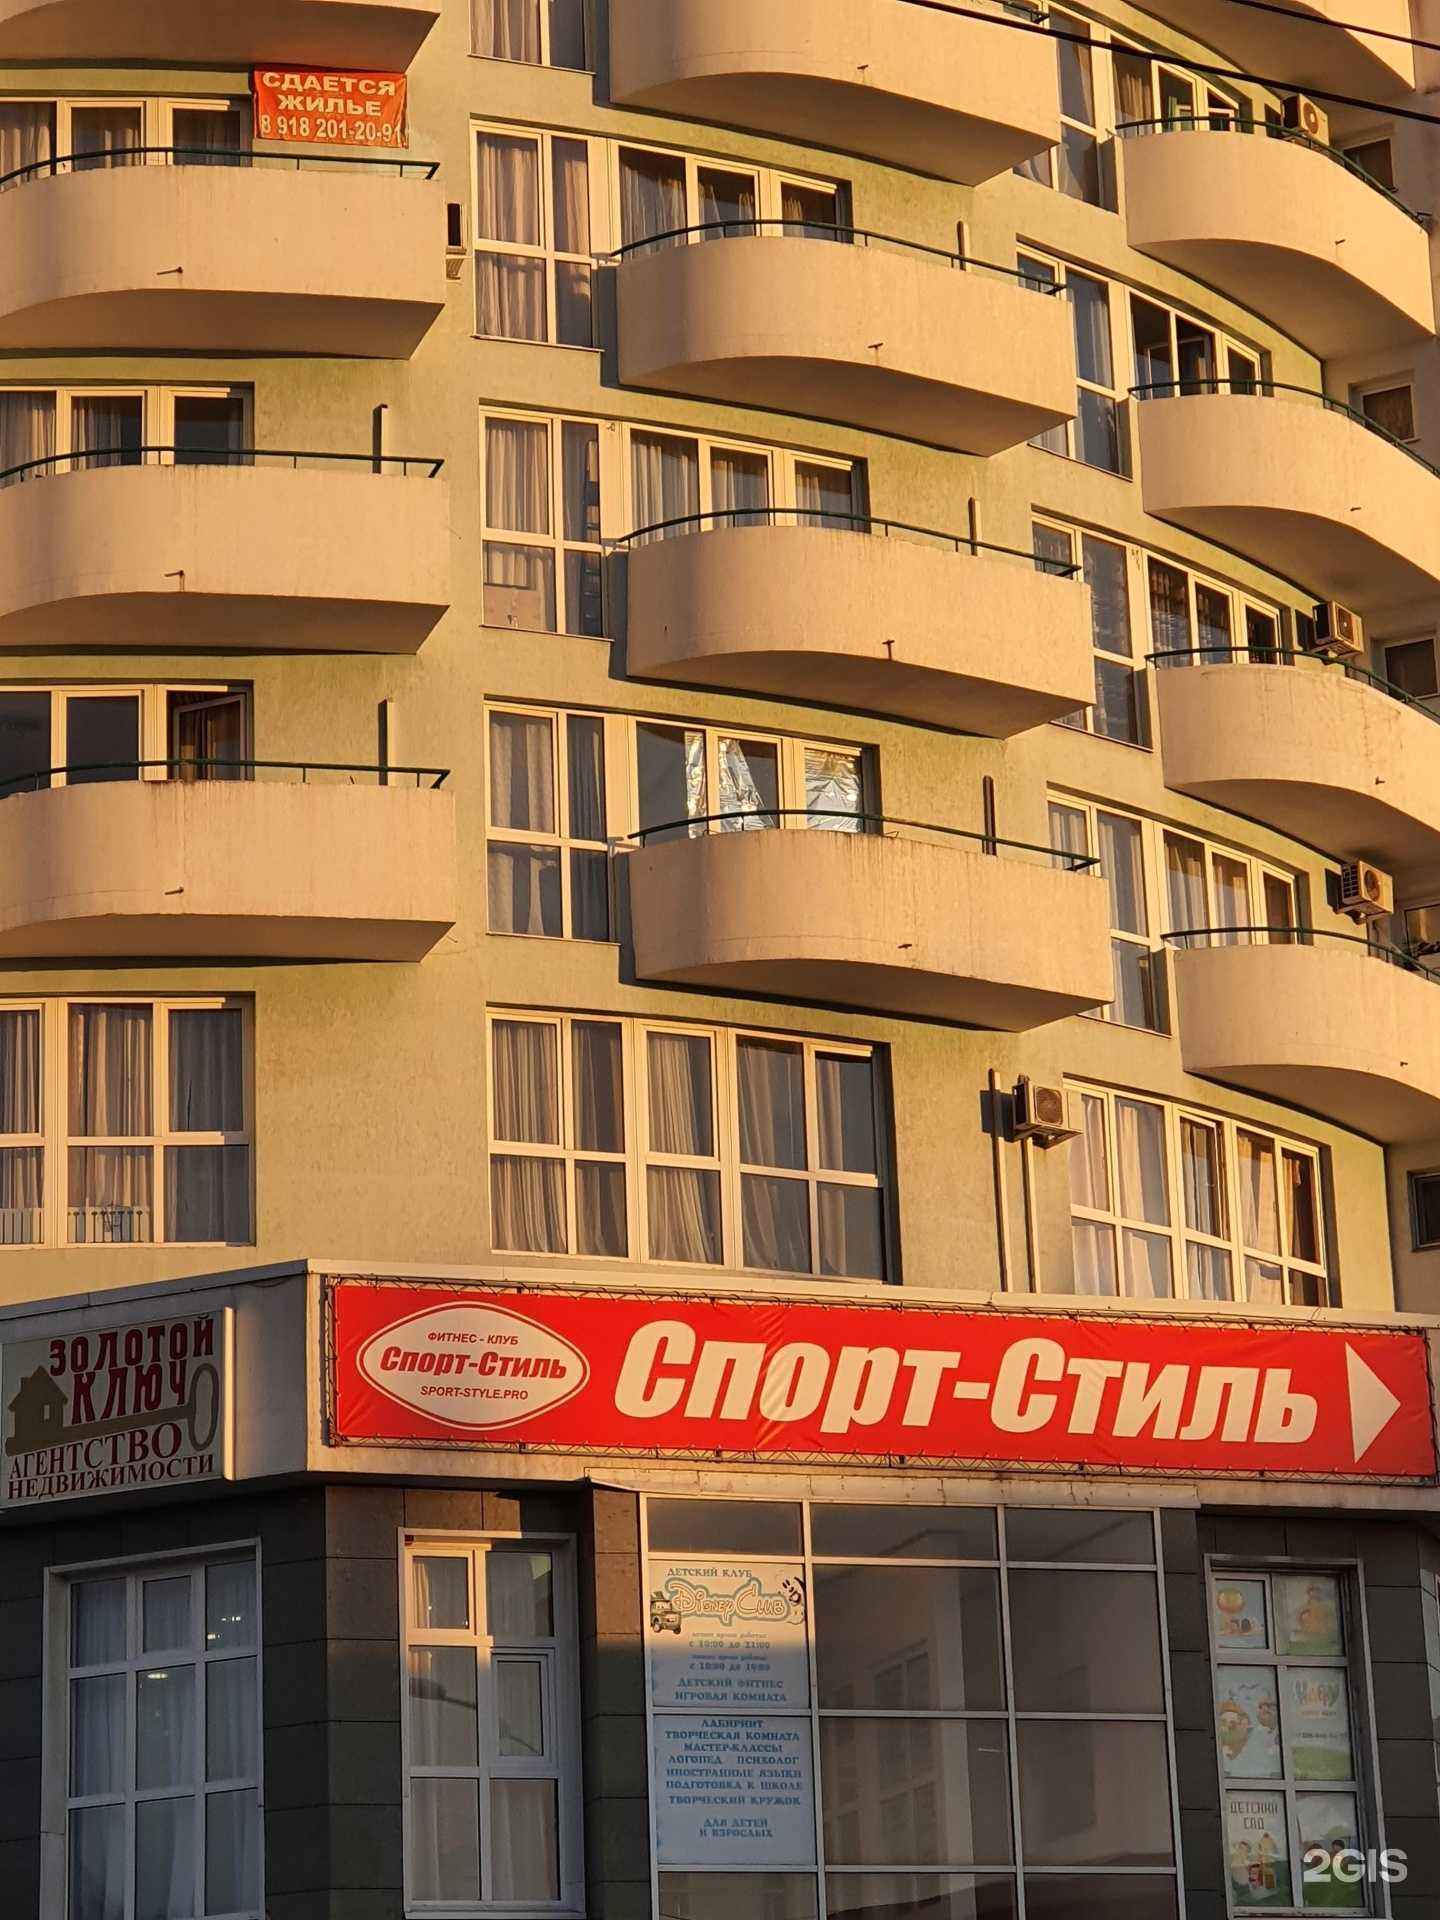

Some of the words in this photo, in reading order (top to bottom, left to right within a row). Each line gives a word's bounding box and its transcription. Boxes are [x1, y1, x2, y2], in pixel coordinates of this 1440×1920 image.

[262, 71, 396, 97] СДАЕТСЯ
[277, 94, 382, 116] ЖИЛЬЕ
[261, 114, 272, 134] 8
[277, 115, 310, 137] 918
[49, 1313, 215, 1377] ЗОЛОТОЙ
[427, 1331, 478, 1345] ФИТНЕС
[487, 1334, 519, 1346] КЛУБ
[379, 1345, 568, 1379] Спорт-Стиль
[71, 1359, 188, 1425] КЛЮЧ
[420, 1385, 529, 1400] SPORT-STYLE.PRO
[613, 1319, 1319, 1445] Спорт-Стиль
[9, 1422, 183, 1479] АГЕНТСТВО
[7, 1454, 214, 1499] НЕДВИЖИМОСТИ
[666, 1567, 718, 1578] ДЕТСКИЙ
[722, 1569, 753, 1579] КЛУБ
[674, 1691, 730, 1701] ИГРОВАЯ
[733, 1692, 787, 1702] КОМНАТА
[664, 1731, 740, 1740] ТВОРЧЕСКАЯ
[745, 1732, 801, 1741] КОМНАТА
[668, 1755, 722, 1765] ЛОГОПЕД
[737, 1755, 801, 1765] ПСИХОЛОГ
[669, 1795, 746, 1805] ТВОРЧЕСКИЙ
